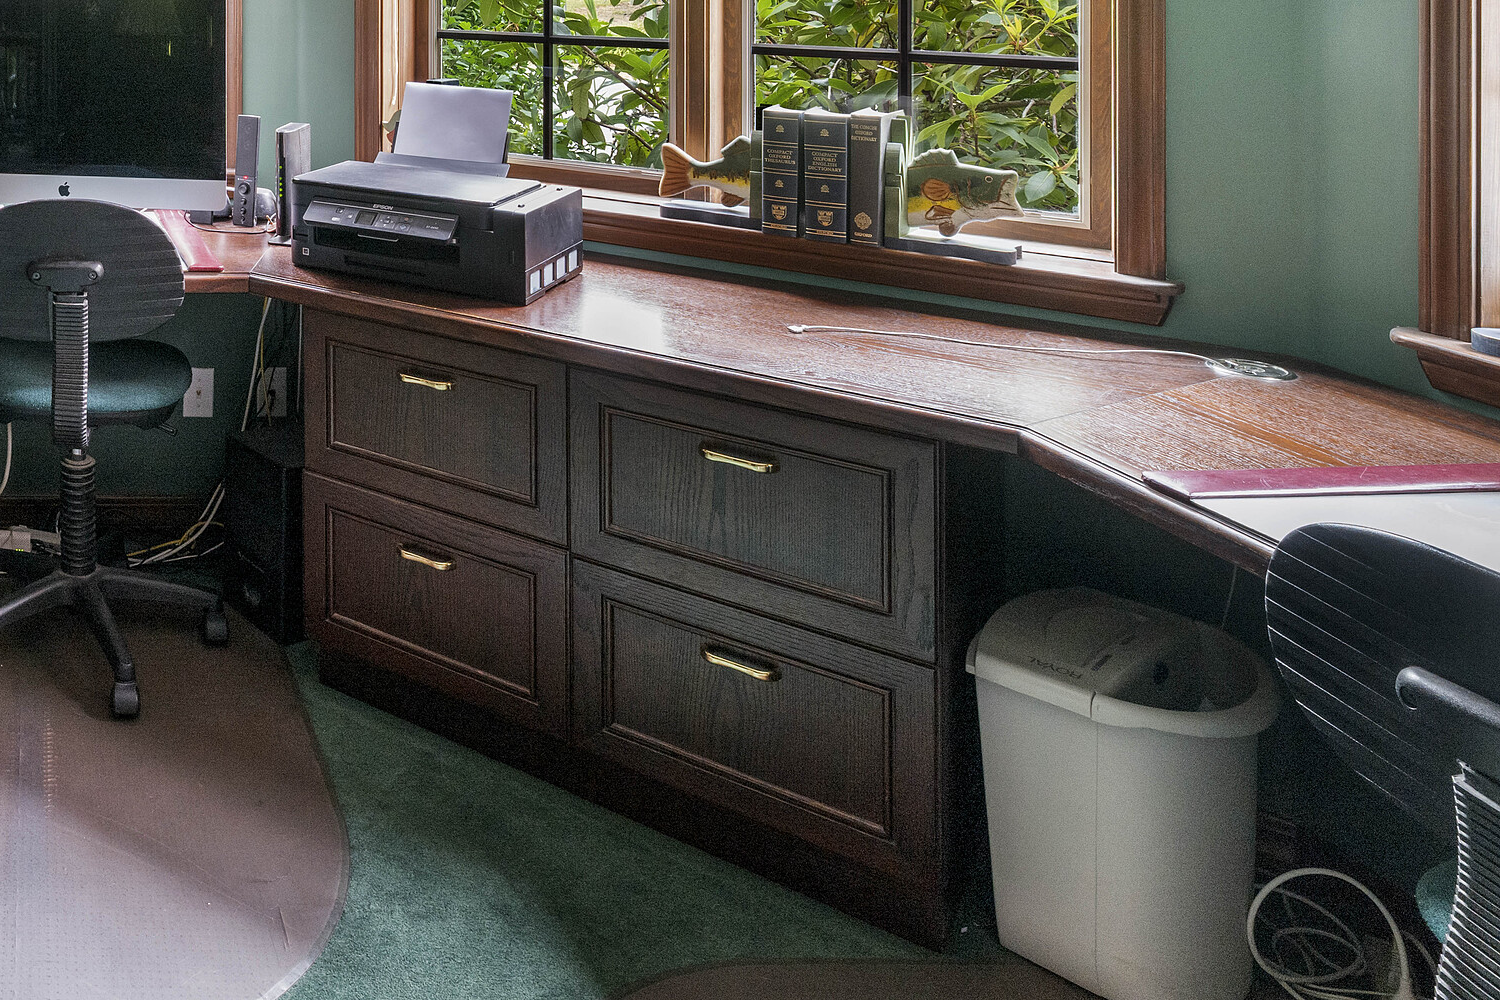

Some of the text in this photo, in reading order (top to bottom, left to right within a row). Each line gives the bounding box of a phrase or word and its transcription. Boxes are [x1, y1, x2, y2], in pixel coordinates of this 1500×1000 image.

[766, 148, 794, 156] COMPACT
[807, 165, 843, 173] DICTIONARY
[372, 203, 394, 211] EPSON
